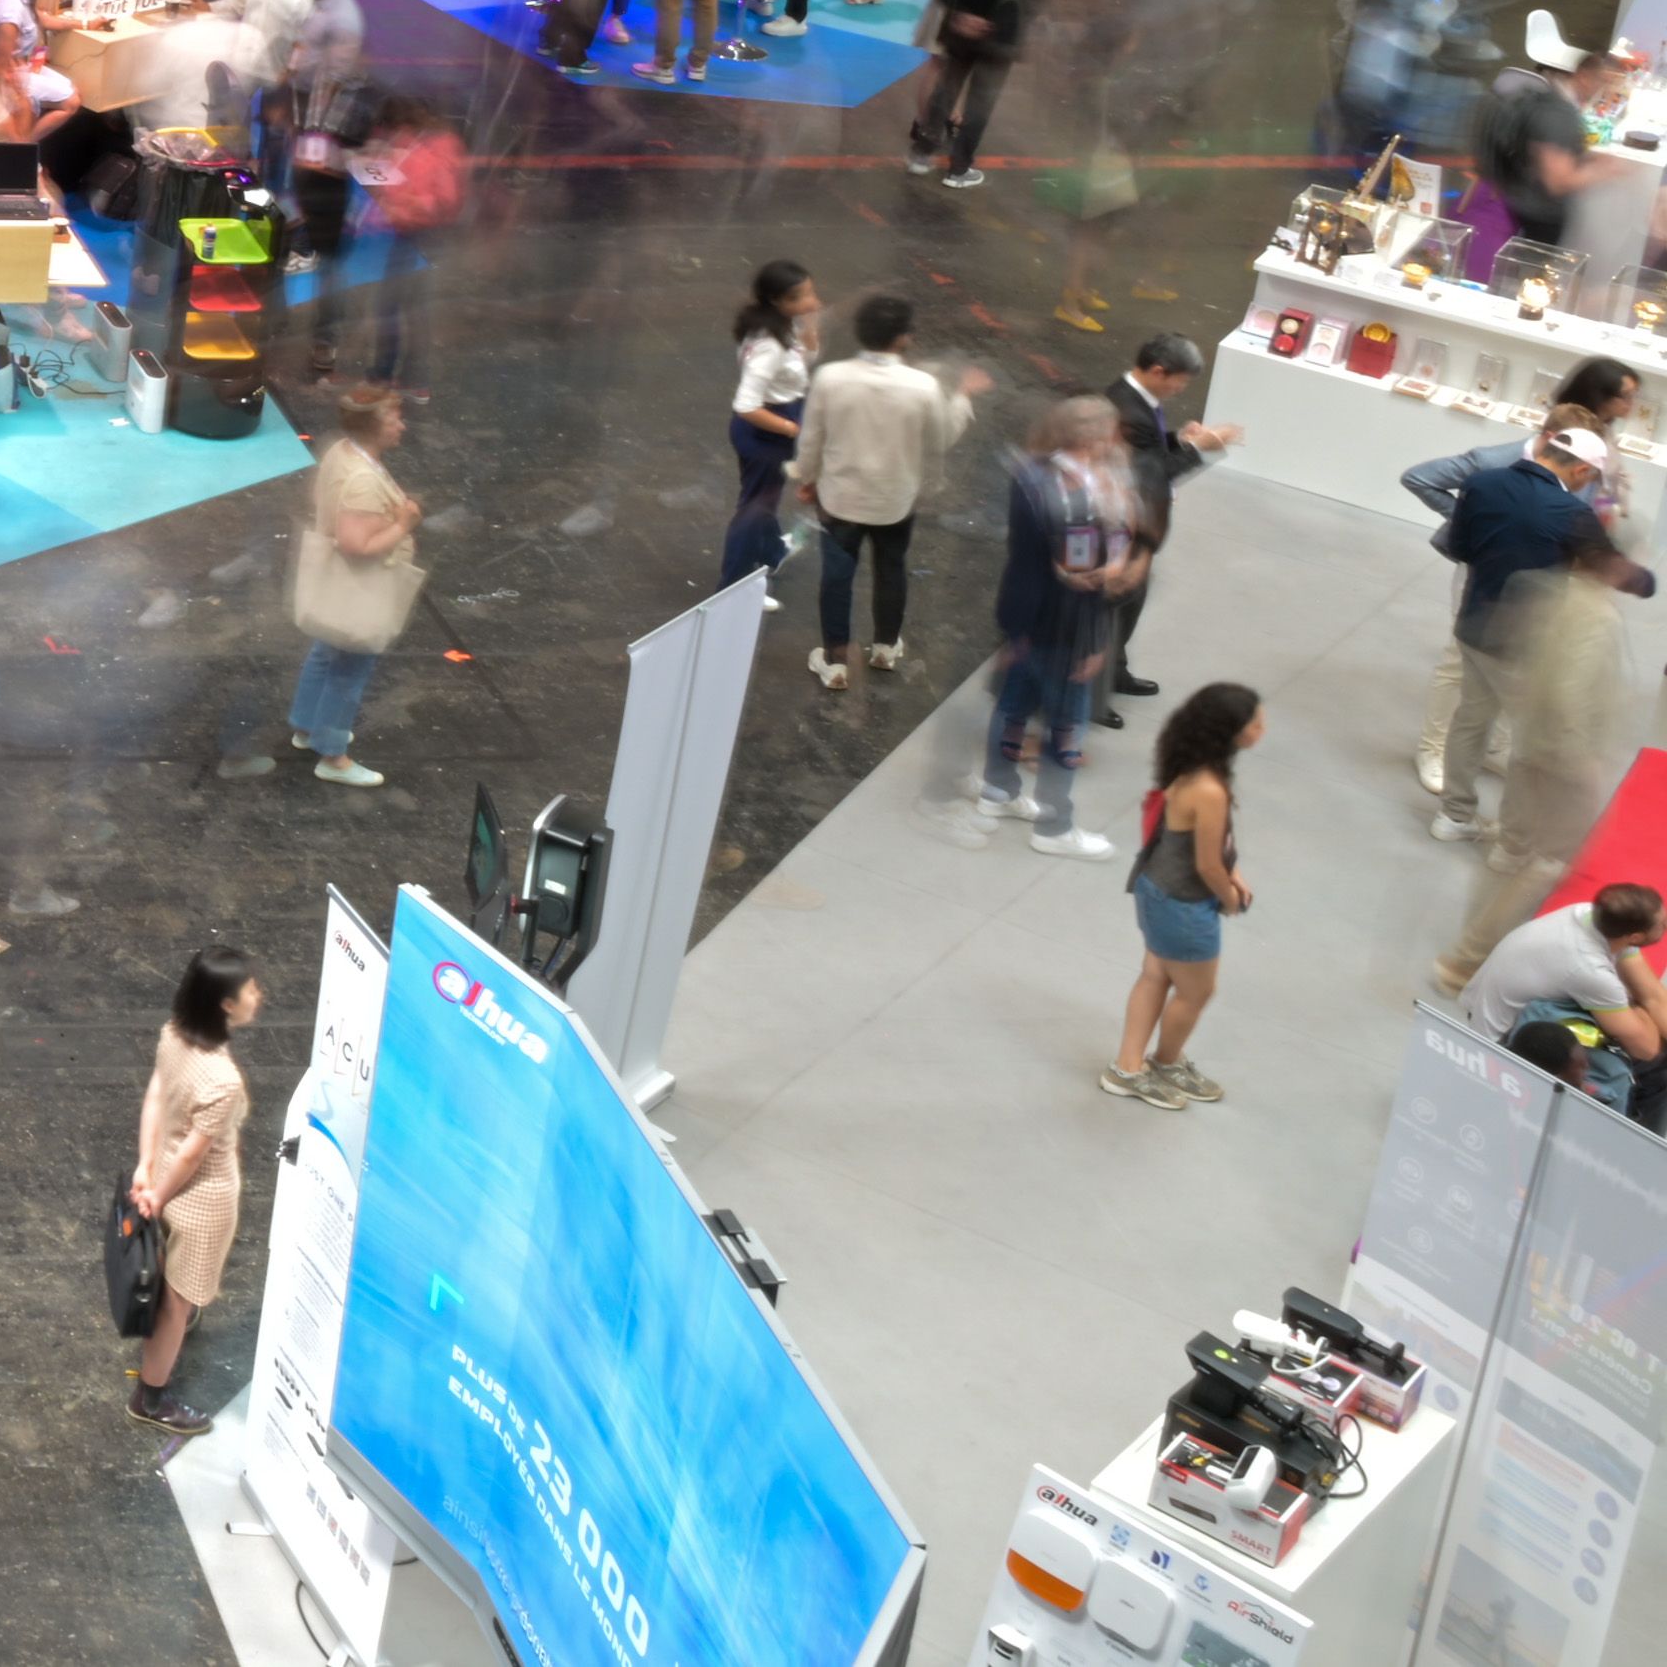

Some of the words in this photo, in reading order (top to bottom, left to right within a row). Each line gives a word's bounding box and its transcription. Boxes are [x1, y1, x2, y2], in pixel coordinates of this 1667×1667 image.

[448, 1375, 536, 1497] EMPLOYÉS
[535, 1494, 573, 1567] DANS
[572, 1561, 592, 1601] LE
[452, 1344, 508, 1405] PLUS
[507, 1399, 526, 1439] DE
[529, 1419, 572, 1517] 23
[577, 1507, 650, 1659] 000
[1228, 1528, 1273, 1557] SMART
[1226, 1601, 1295, 1646] AirShield
